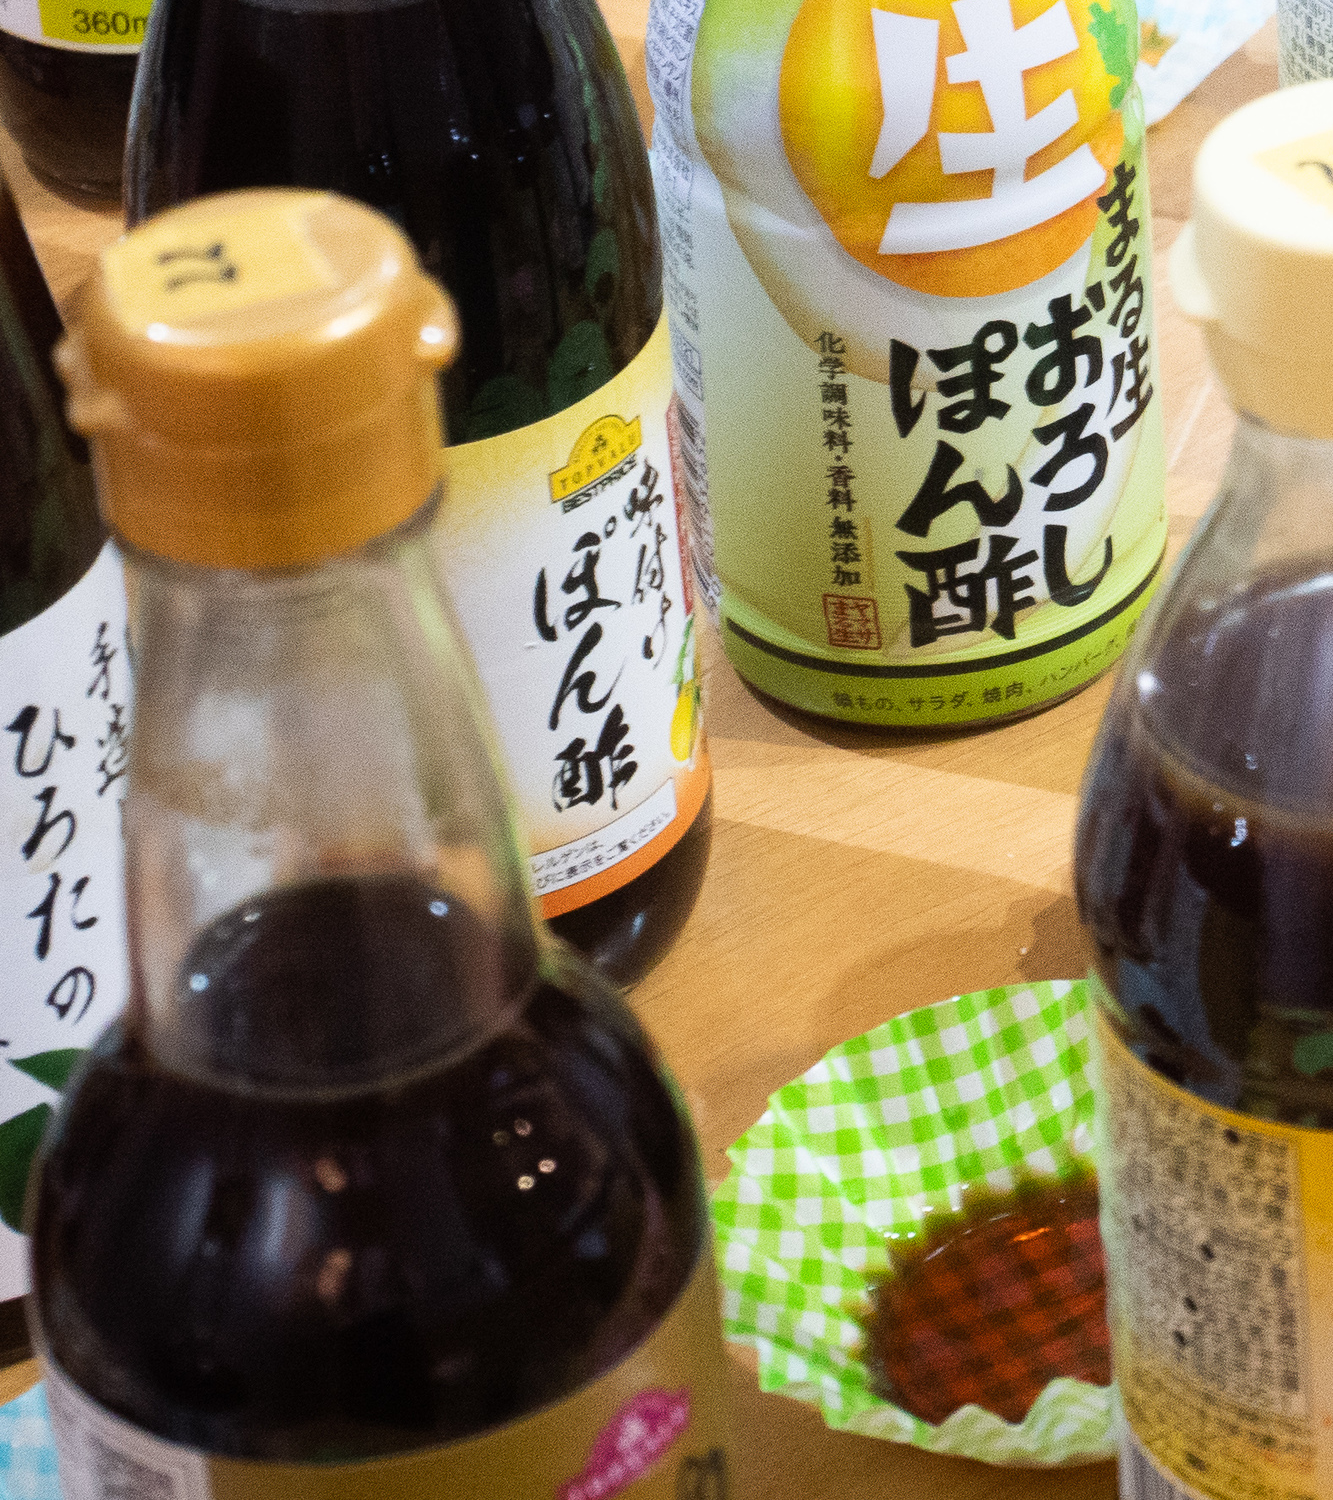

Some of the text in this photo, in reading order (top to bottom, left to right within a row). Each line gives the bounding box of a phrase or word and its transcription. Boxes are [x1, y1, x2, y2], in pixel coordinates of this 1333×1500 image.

[1022, 280, 1113, 607] おろし
[1096, 160, 1155, 443] まる生
[889, 318, 1041, 648] ぽん酢
[533, 515, 640, 814] ぽん酢
[4, 704, 100, 1026] ひろたの
